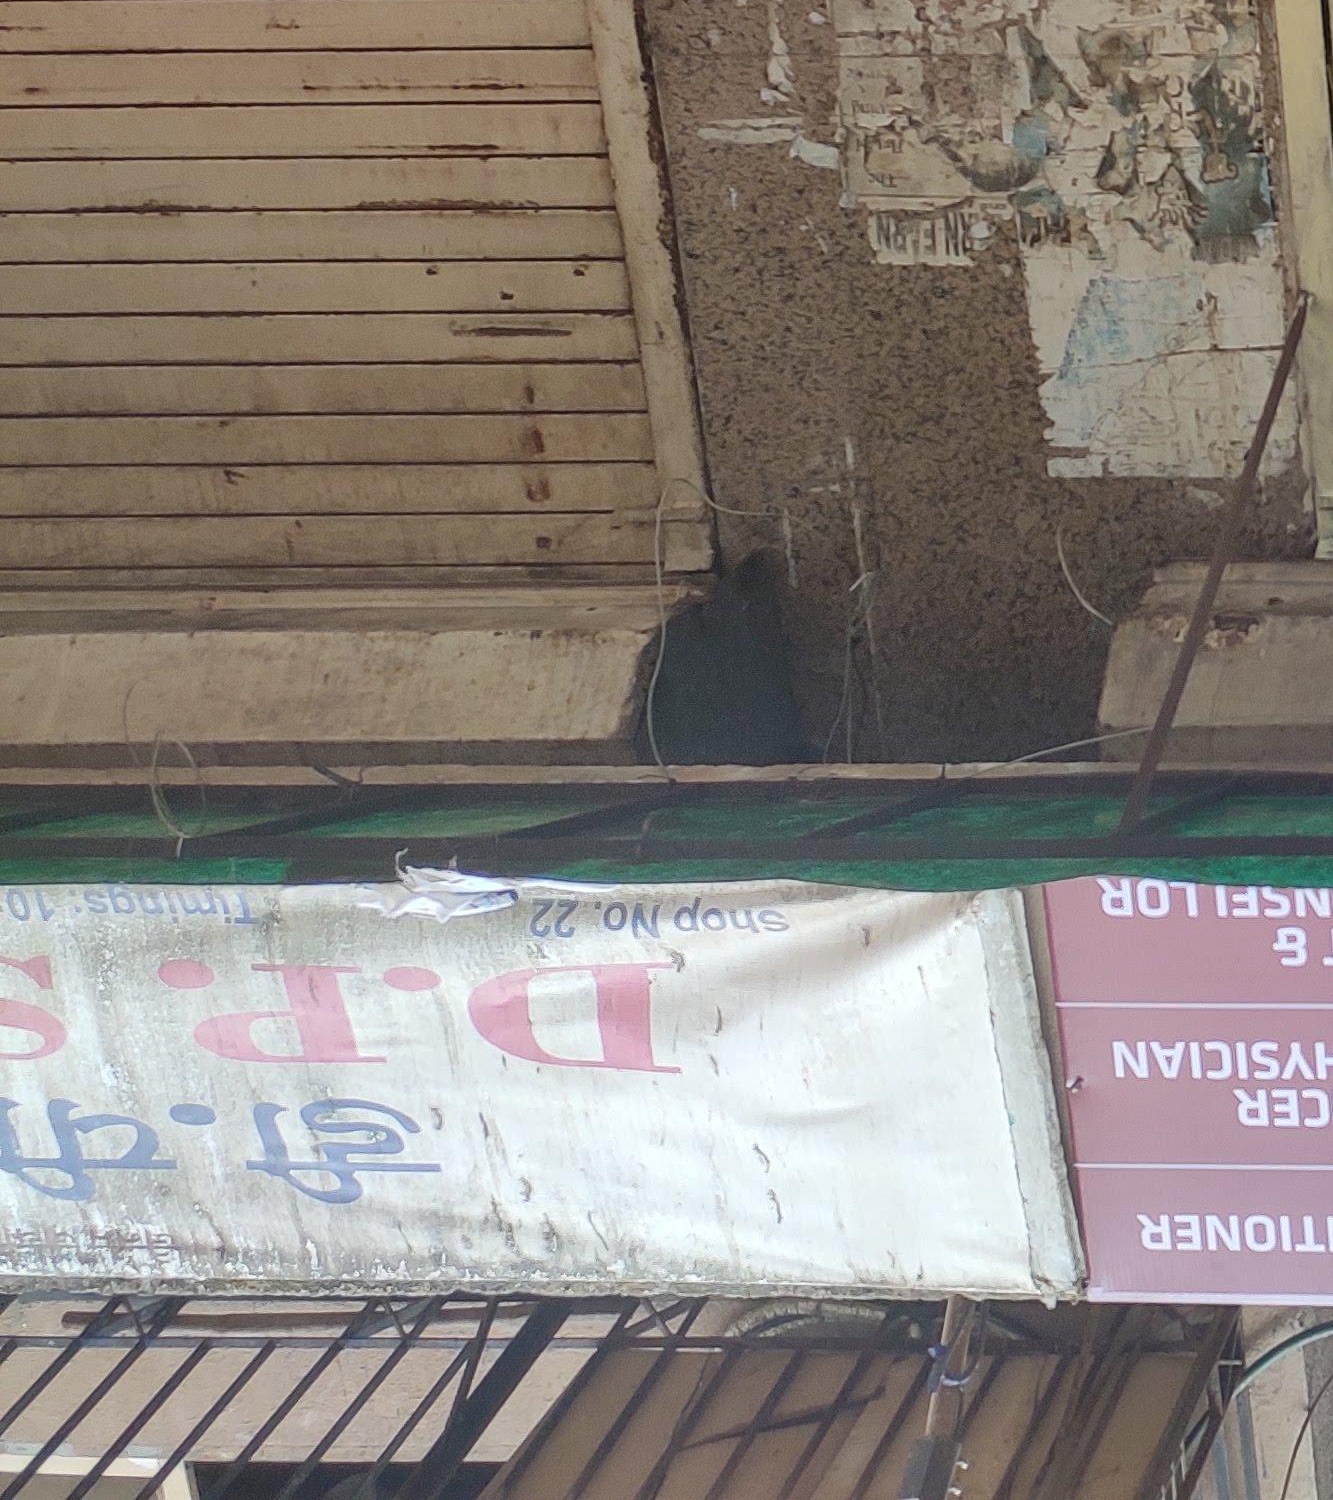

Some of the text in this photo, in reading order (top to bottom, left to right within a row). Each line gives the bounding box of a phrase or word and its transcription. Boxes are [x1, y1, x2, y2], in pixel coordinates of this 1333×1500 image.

[68, 882, 259, 927] Timings:
[528, 898, 579, 939] 22
[593, 900, 660, 940] No.
[1272, 925, 1307, 967] &
